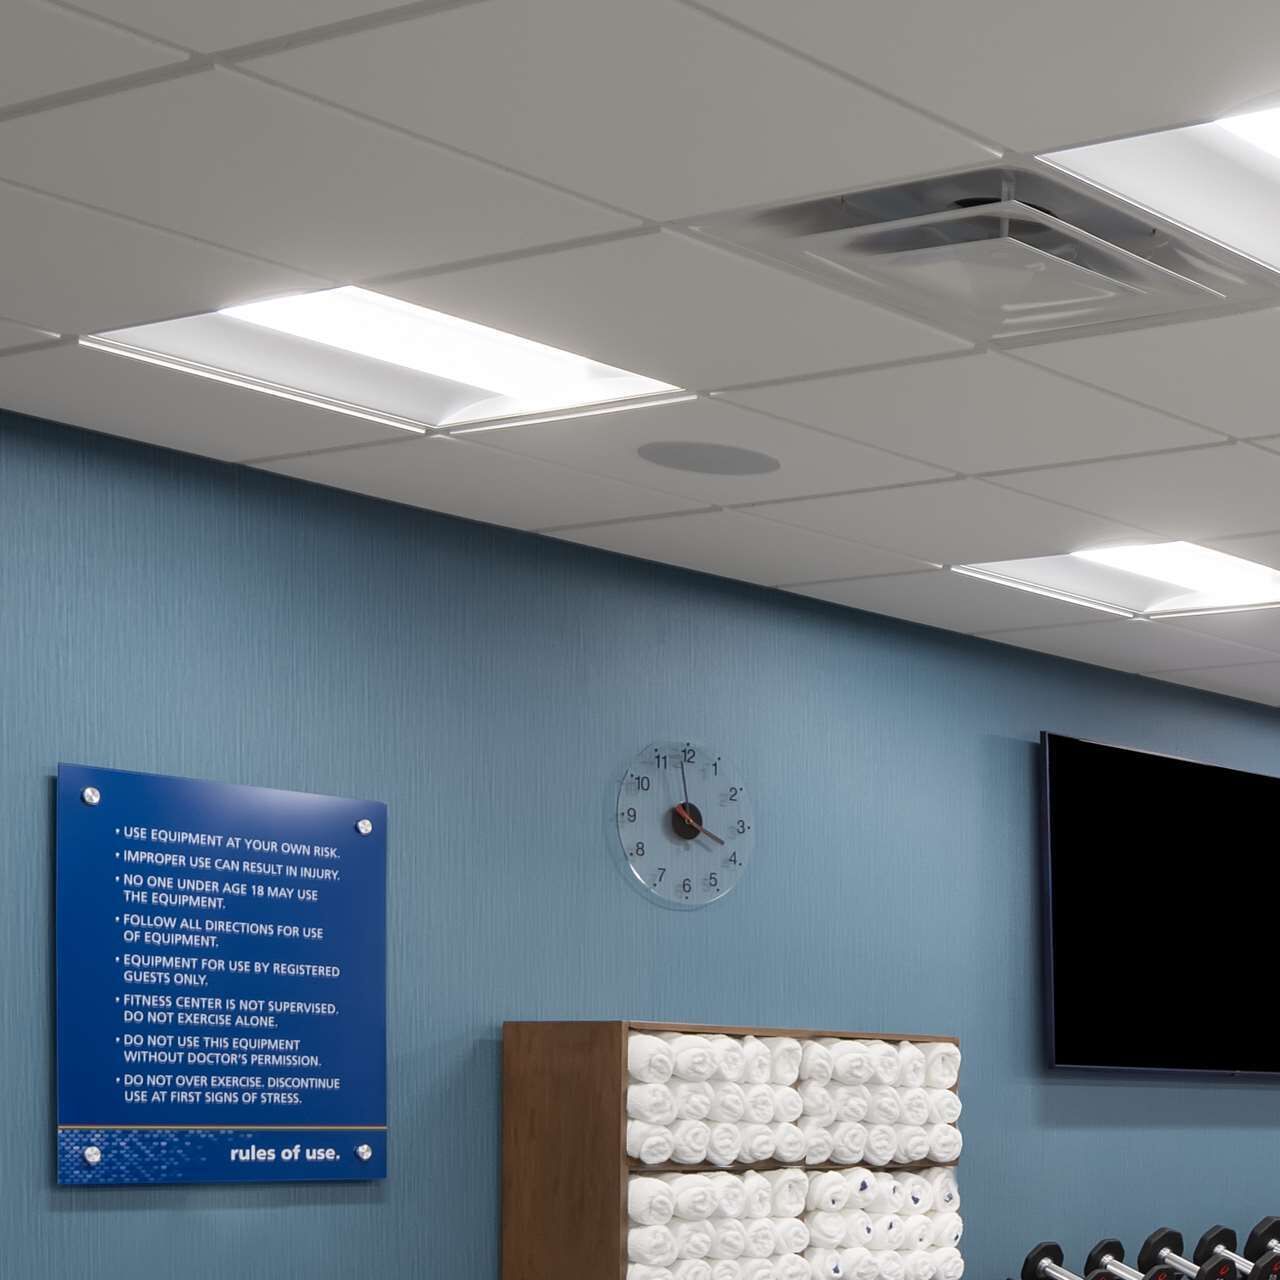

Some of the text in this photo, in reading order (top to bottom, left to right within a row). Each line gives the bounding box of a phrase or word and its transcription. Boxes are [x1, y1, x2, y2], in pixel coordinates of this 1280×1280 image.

[655, 755, 668, 770] 11
[682, 749, 696, 764] 12
[712, 762, 719, 776] 1
[635, 776, 650, 791] 10
[729, 787, 738, 801] 2
[627, 808, 637, 823] 9
[736, 820, 745, 834] 3
[123, 825, 341, 859] USE EQUIPMENT AT YOUR OWN RISK.
[636, 841, 645, 857] 8
[123, 849, 340, 881] IMPROPER USE CAN RESULT IN INJURY.
[728, 851, 737, 865] 4
[657, 868, 666, 882] 7
[709, 872, 718, 887] 5
[123, 873, 318, 902] NO ONE UNDER AGE 18 MAY USE
[682, 878, 692, 893] 6
[123, 889, 226, 910] THE EQUIPMENT.
[123, 913, 324, 940] FOLLOW ALL DIRECTIONS FOR USE
[123, 929, 219, 948] OF EQUIPMENT.
[123, 953, 341, 978] EQUIPMENT FOR USE BY REGISTERED
[123, 969, 209, 987] GUESTS ONLY.
[123, 993, 339, 1015] FITNESS CENTER IS NOT SUPERVISED.
[123, 1010, 278, 1028] DO NOT EXERCISE ALONE.
[123, 1033, 301, 1052] DO NOT USE THIS EQUIPMENT
[123, 1050, 322, 1067] WITHOUT DOCTOR'S PERMISSION.
[124, 1073, 341, 1090] DO NOT OVER EXERCISE. DISCONTINUE
[124, 1090, 303, 1105] USE AT FIRST SIGNS OF STRESS.
[230, 1143, 341, 1162] rules of use.
